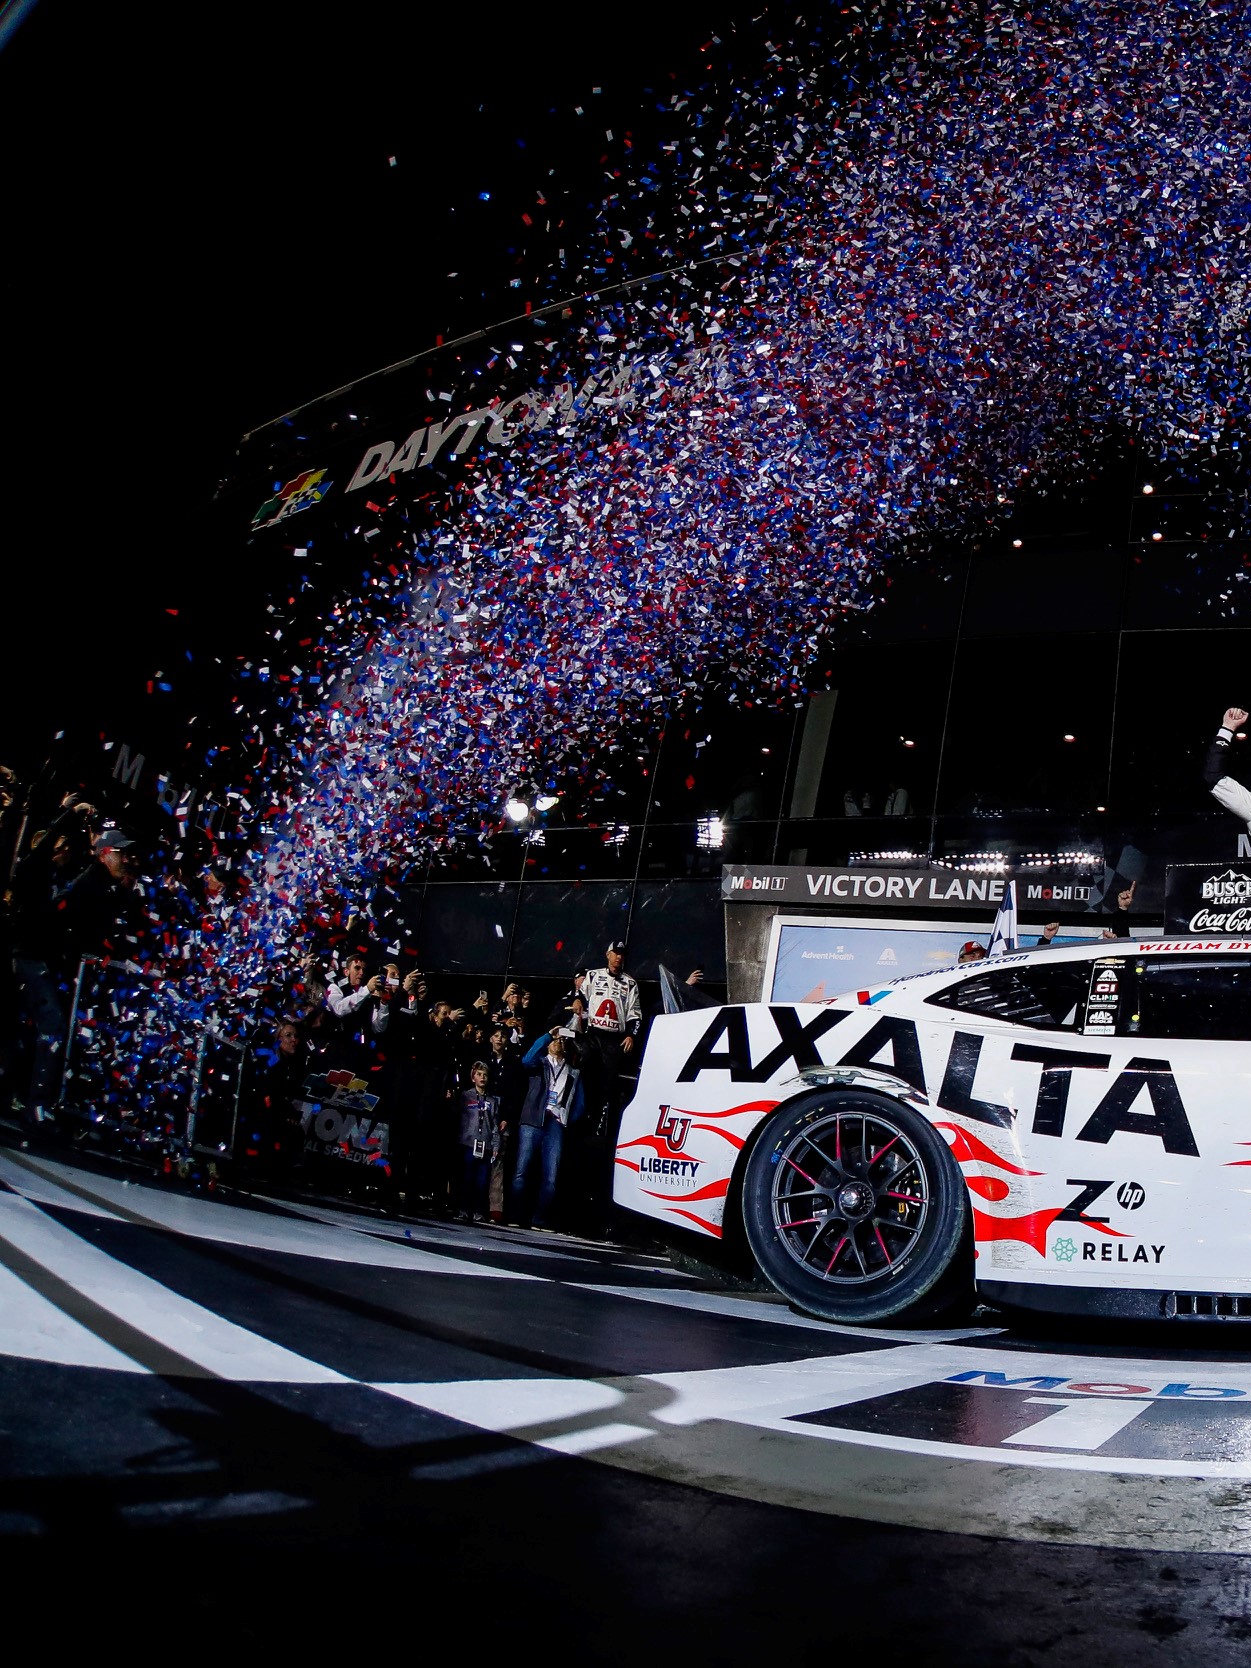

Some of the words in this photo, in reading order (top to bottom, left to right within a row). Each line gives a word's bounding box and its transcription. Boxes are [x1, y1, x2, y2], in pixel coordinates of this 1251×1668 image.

[731, 876, 769, 890] Mobil
[806, 874, 923, 899] VICTORY
[929, 878, 1005, 901] LANE
[1027, 885, 1072, 900] Mobil
[1212, 896, 1246, 904] LIGHT
[1139, 942, 1222, 952] WILLIAM
[801, 951, 854, 961] AdventHealth
[676, 1007, 1199, 1157] AXALTA
[641, 1157, 699, 1177] LIBERTY
[640, 1174, 697, 1187] UNIVERSITY
[1083, 1242, 1165, 1263] RELAY
[1001, 1396, 1155, 1451] 1
